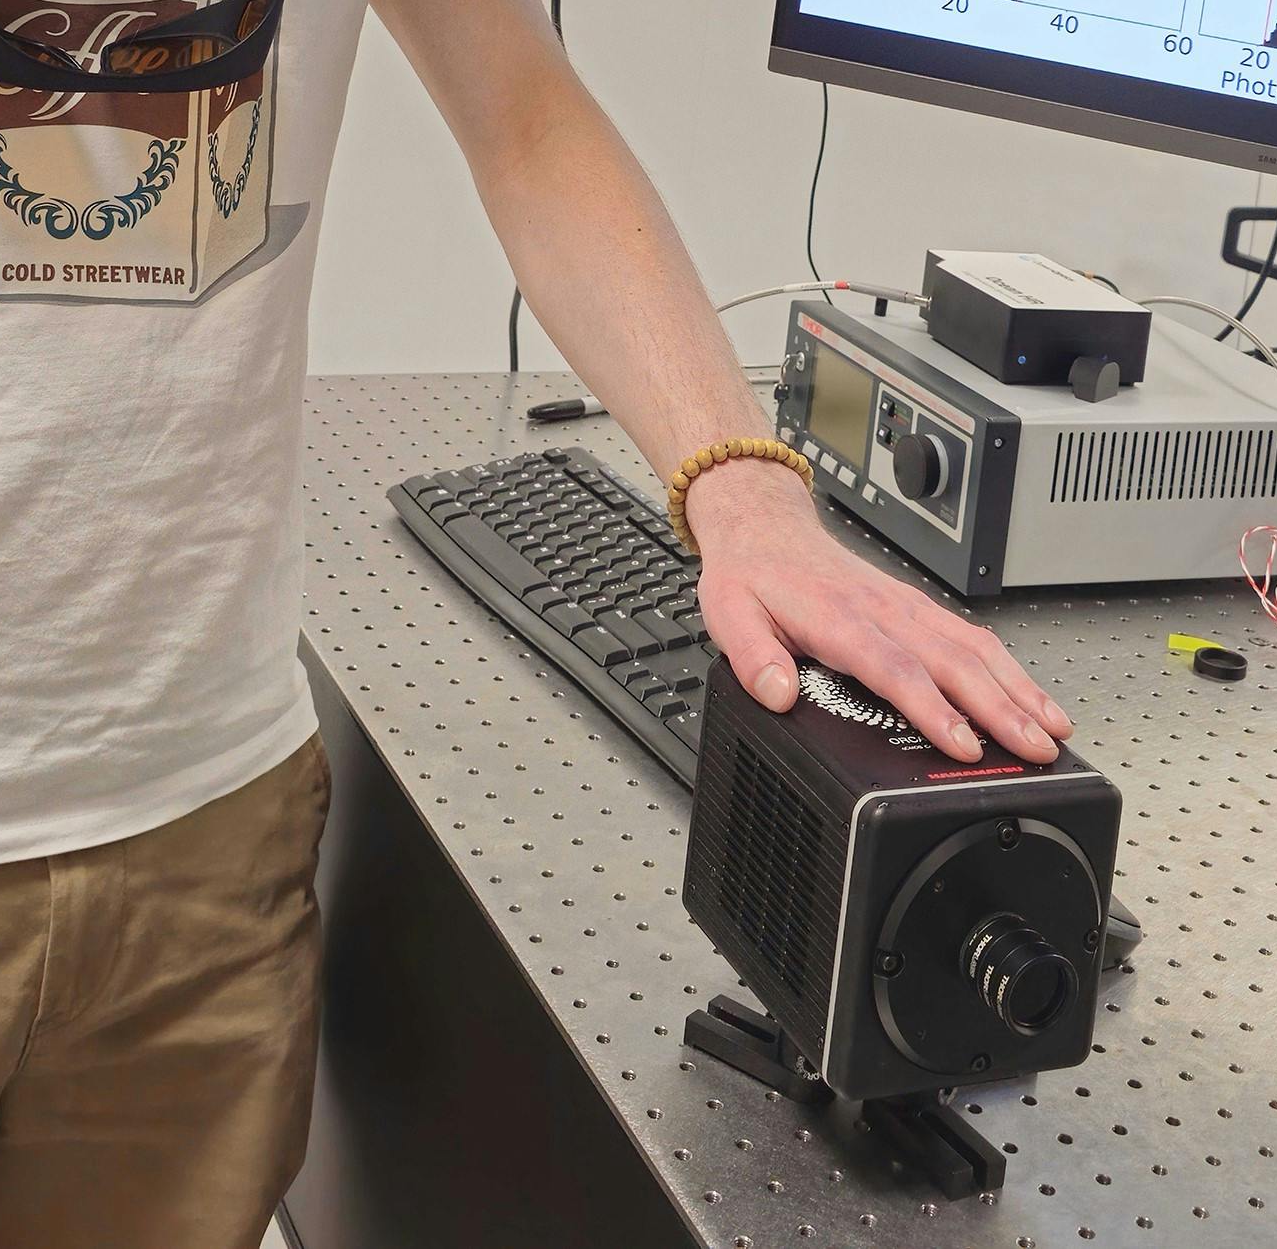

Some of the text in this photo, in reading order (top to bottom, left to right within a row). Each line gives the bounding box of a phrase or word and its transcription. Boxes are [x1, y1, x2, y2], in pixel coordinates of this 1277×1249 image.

[1050, 13, 1080, 35] 40
[1163, 34, 1194, 57] 60
[1239, 47, 1271, 70] 20
[2, 263, 56, 283] COLD
[61, 265, 186, 285] STREETWEAR
